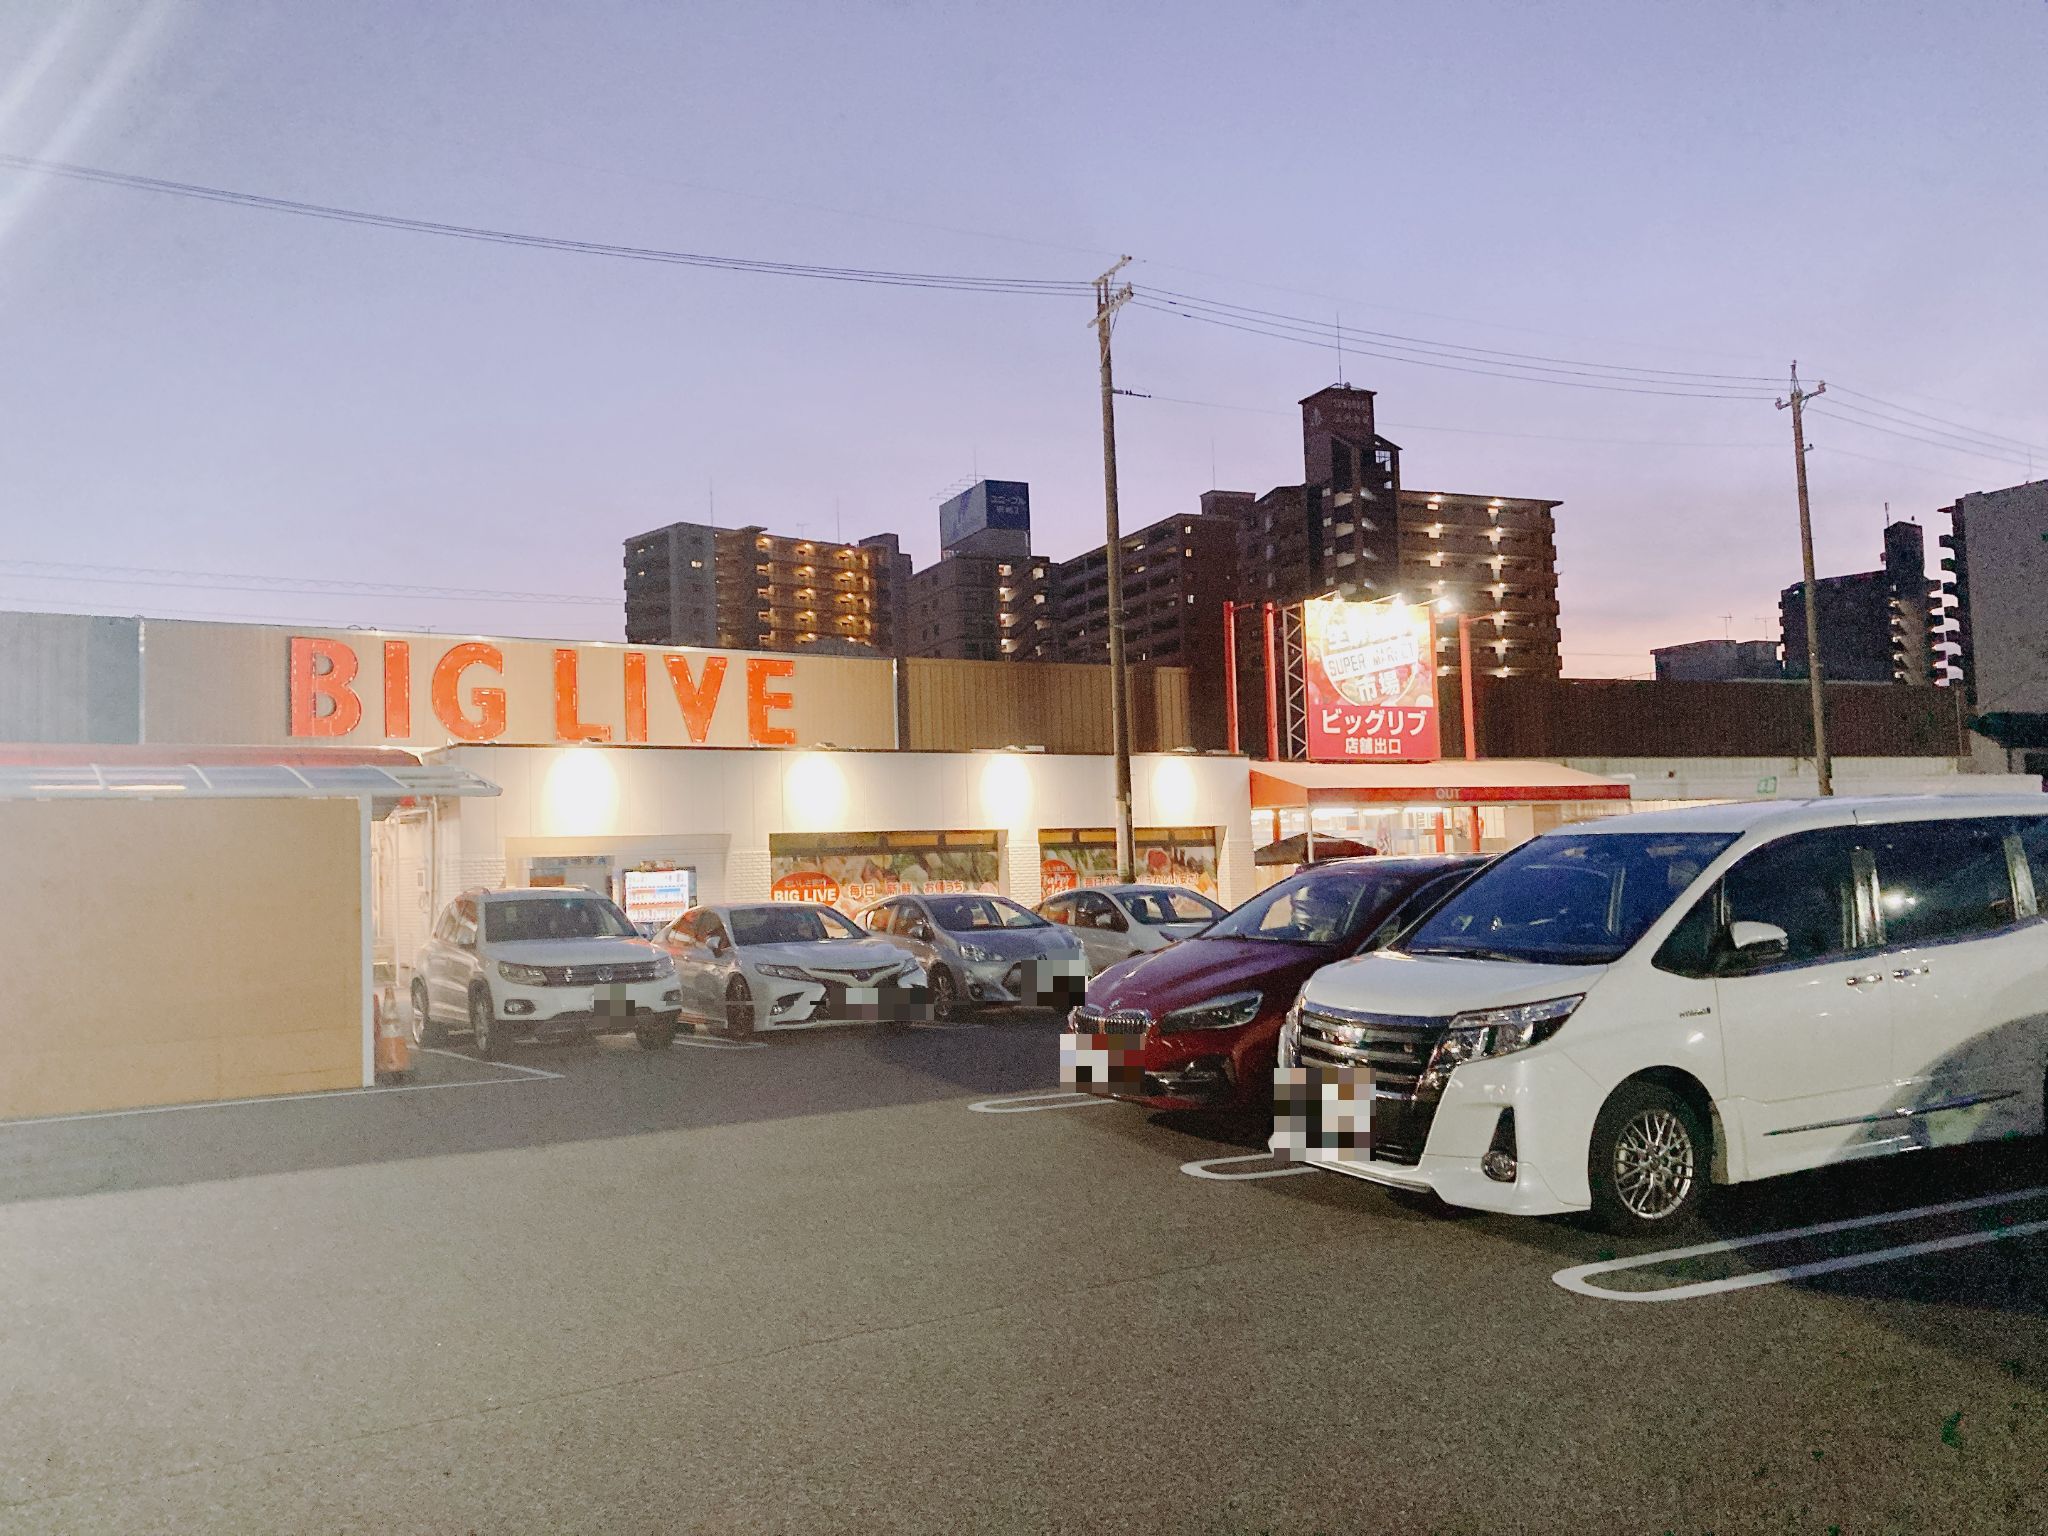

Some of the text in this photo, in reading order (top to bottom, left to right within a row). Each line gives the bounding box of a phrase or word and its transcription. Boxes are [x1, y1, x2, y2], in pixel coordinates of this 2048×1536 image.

[1327, 653, 1366, 677] SUPER
[290, 636, 798, 745] BIG LIVE
[1356, 670, 1401, 704] 市場
[1321, 708, 1428, 737] ビッグリブ
[1344, 737, 1402, 755] 店舗出口
[1435, 787, 1461, 800] OUT
[774, 888, 837, 902] BIG LIVE
[849, 883, 876, 898] 毎日
